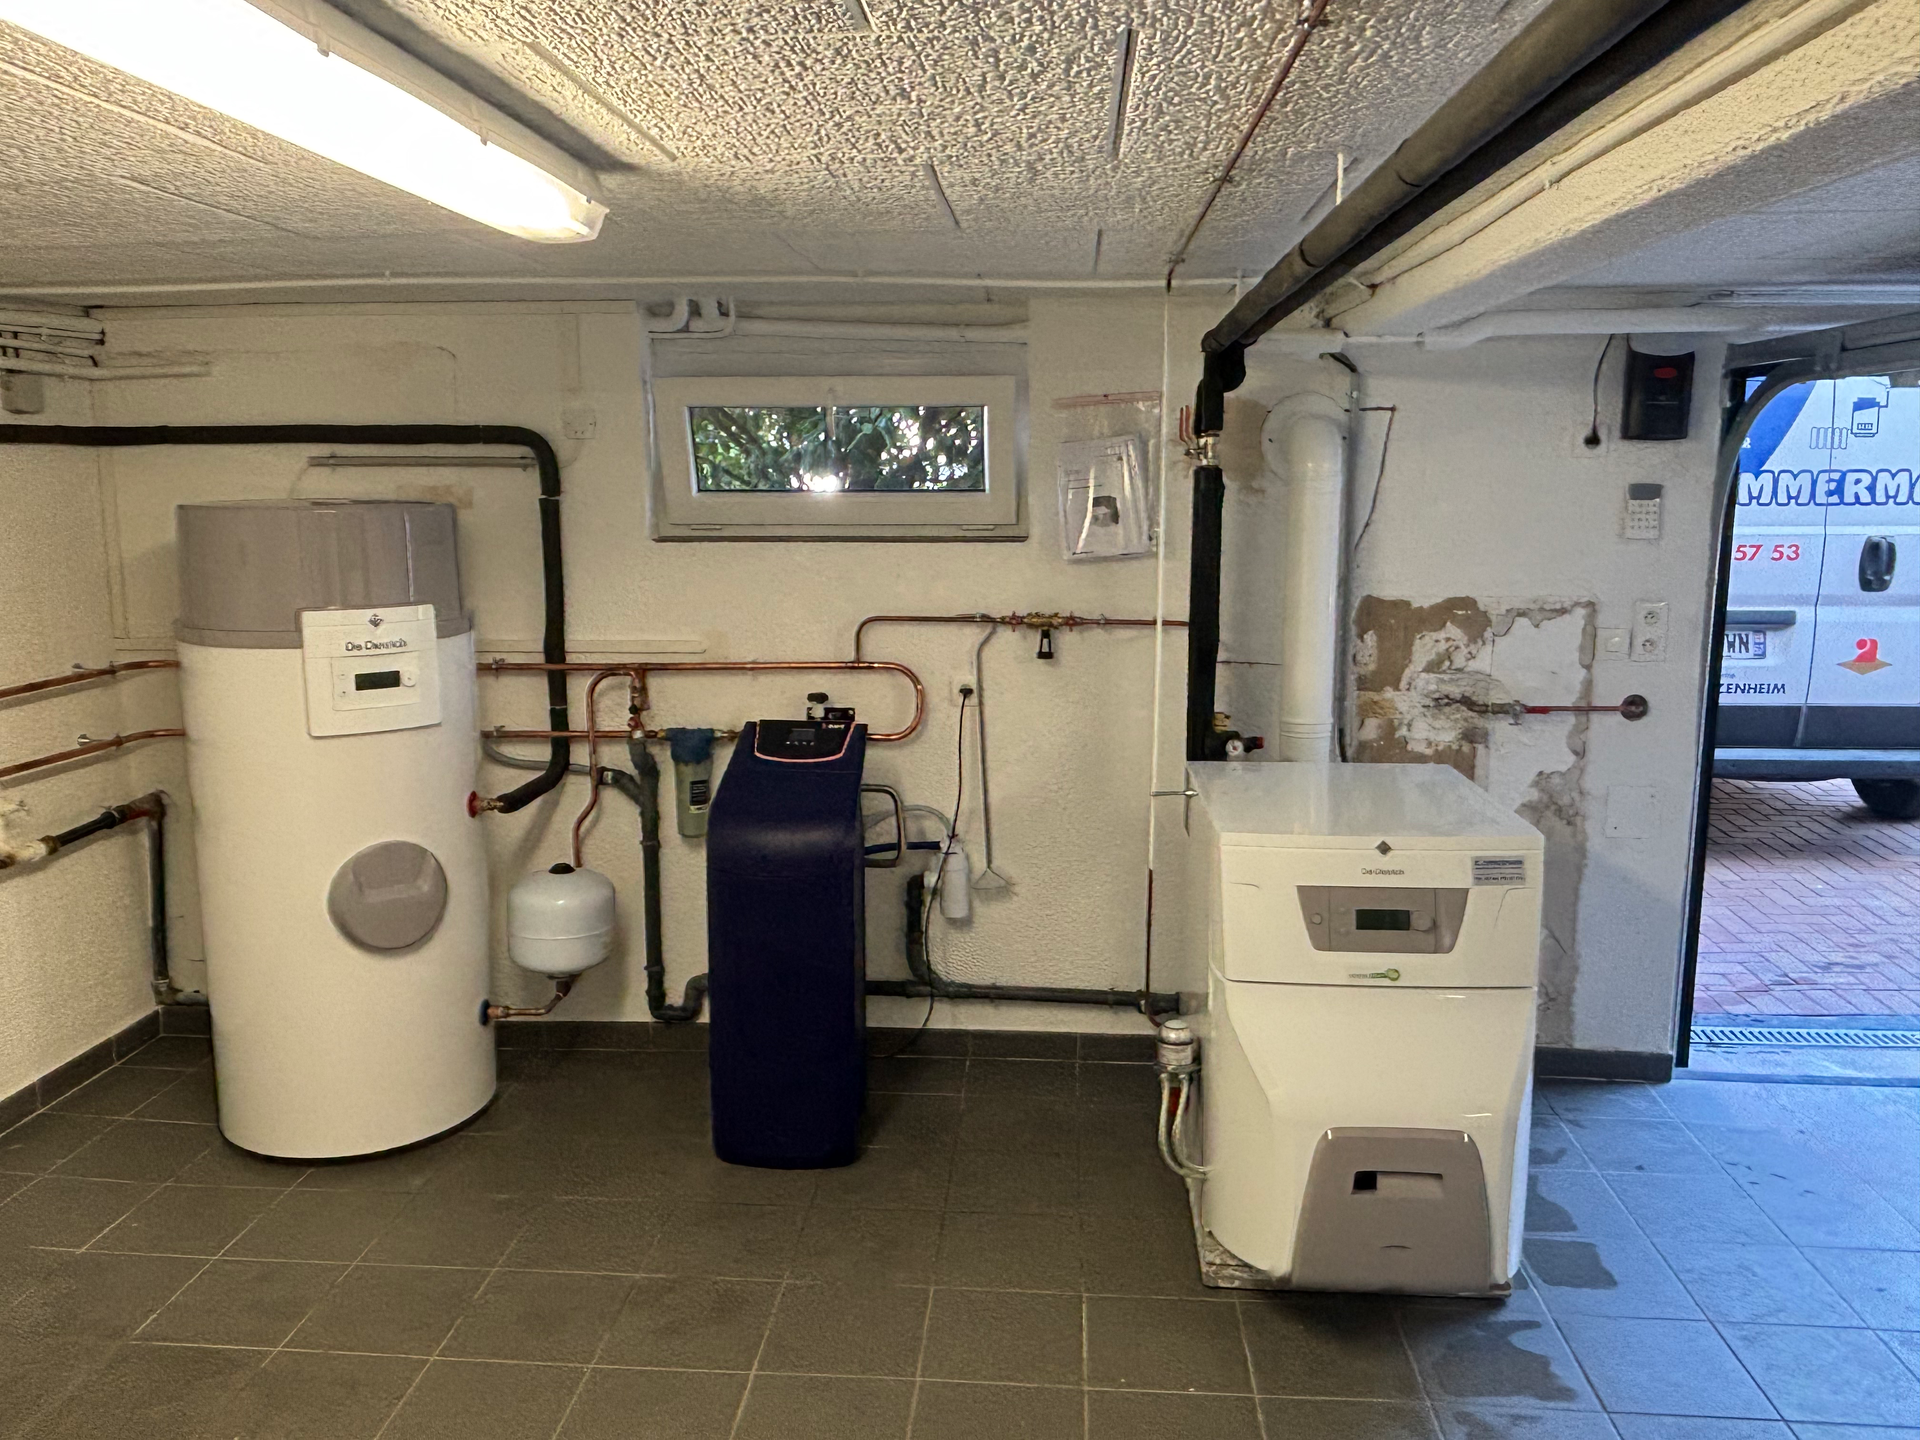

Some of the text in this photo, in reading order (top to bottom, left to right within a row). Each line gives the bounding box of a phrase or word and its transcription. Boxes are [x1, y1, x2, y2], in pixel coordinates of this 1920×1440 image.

[1736, 468, 1920, 507] MMERM
[1733, 544, 1801, 562] 57 53
